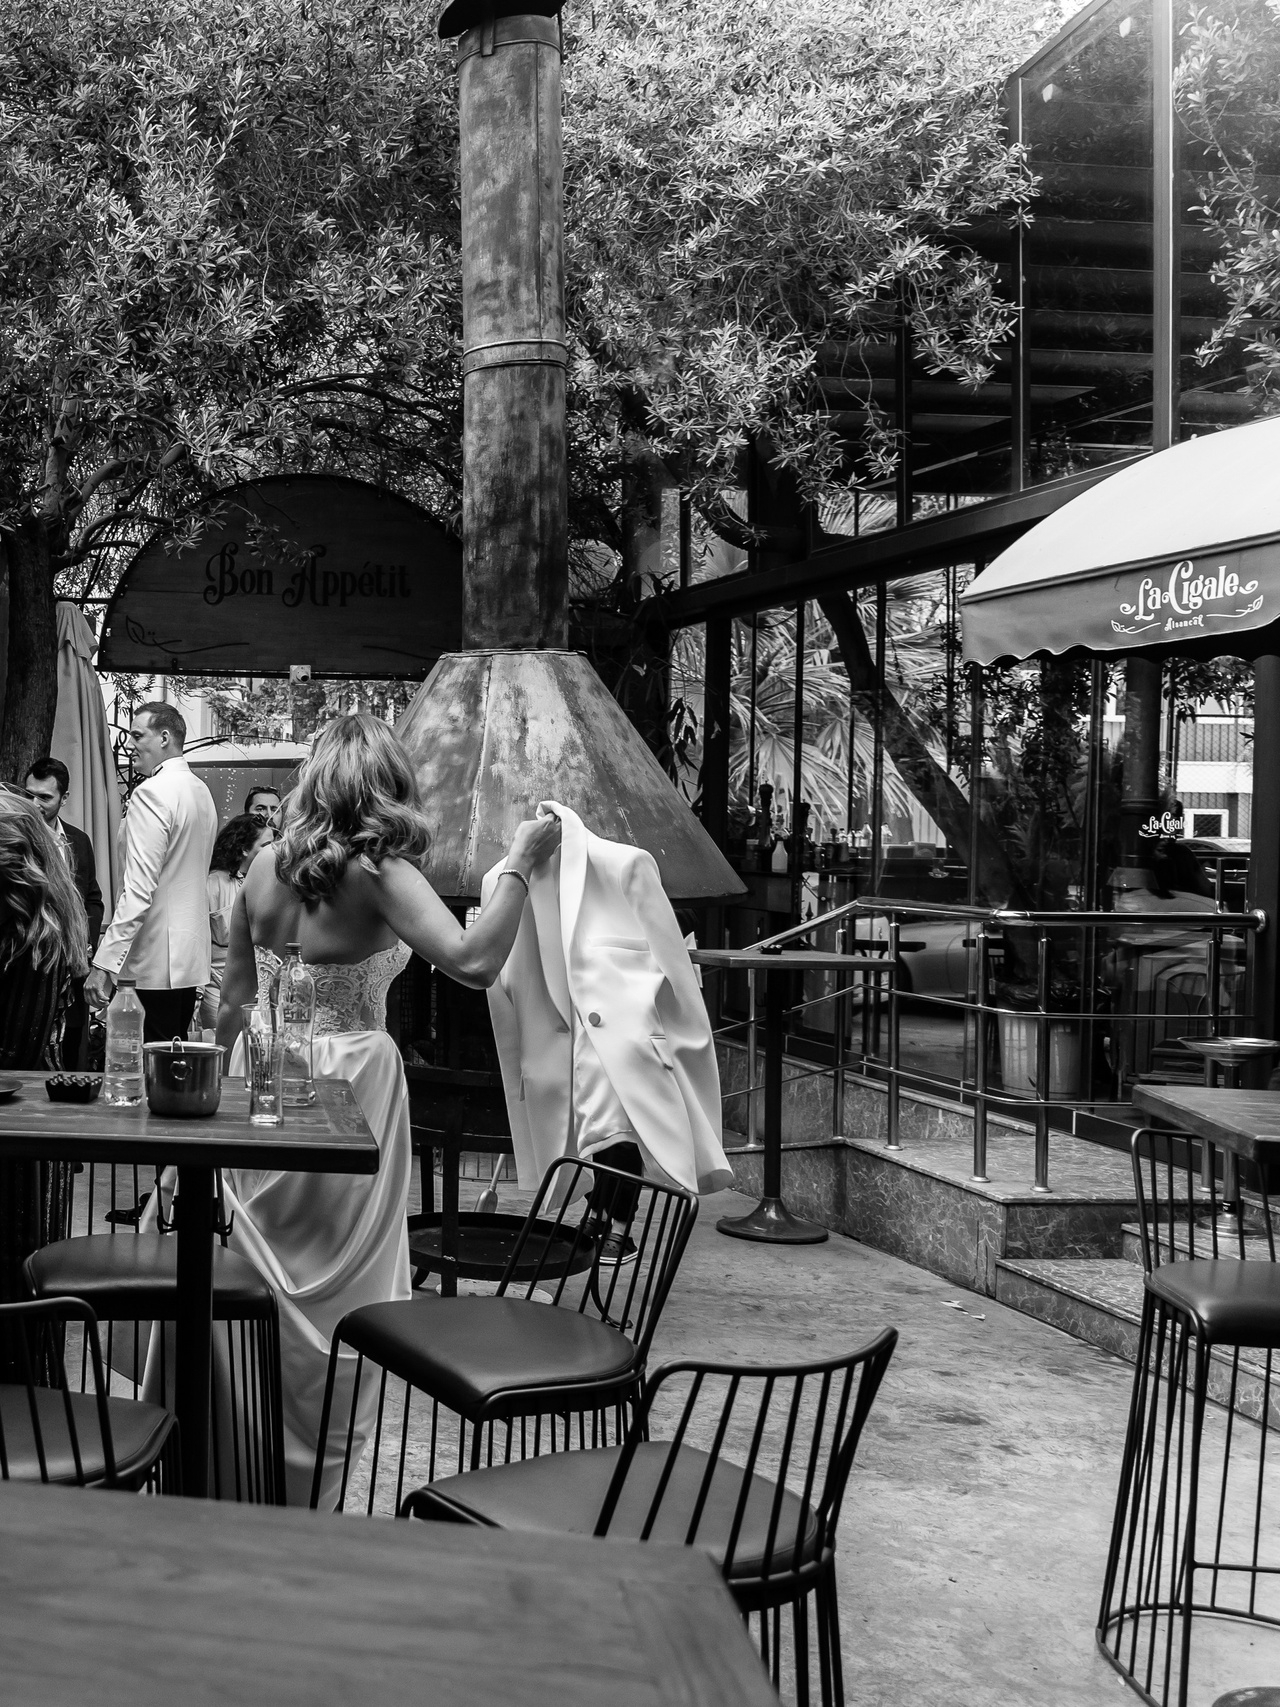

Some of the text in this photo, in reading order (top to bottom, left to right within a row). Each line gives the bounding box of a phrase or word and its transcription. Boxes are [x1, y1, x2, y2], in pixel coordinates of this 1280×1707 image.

[203, 542, 412, 608] Bon Appétit
[1119, 560, 1259, 621] La Cigale
[1141, 815, 1160, 834] La
